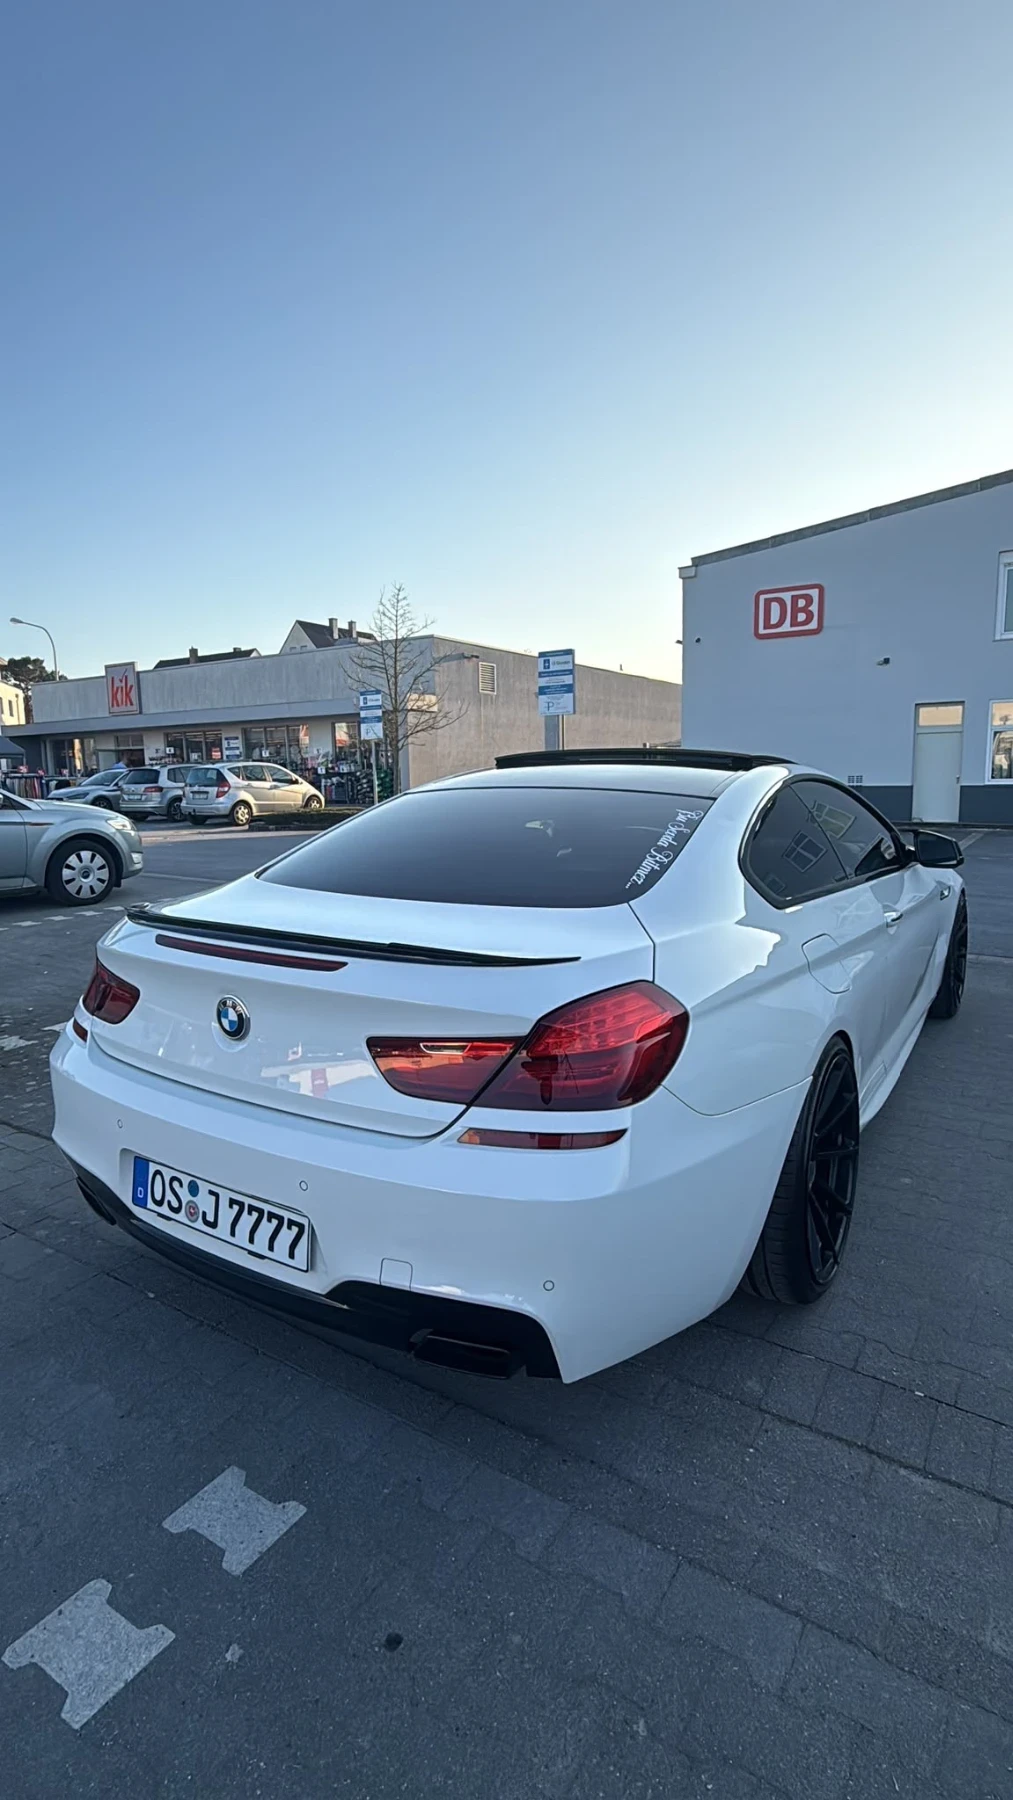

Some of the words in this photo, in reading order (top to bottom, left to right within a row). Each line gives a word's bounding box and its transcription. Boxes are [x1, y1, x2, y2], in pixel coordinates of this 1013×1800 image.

[763, 593, 814, 630] DB
[137, 1187, 144, 1198] D
[151, 1169, 183, 1214] OS
[201, 1189, 220, 1230] J
[228, 1197, 306, 1260] 7777
